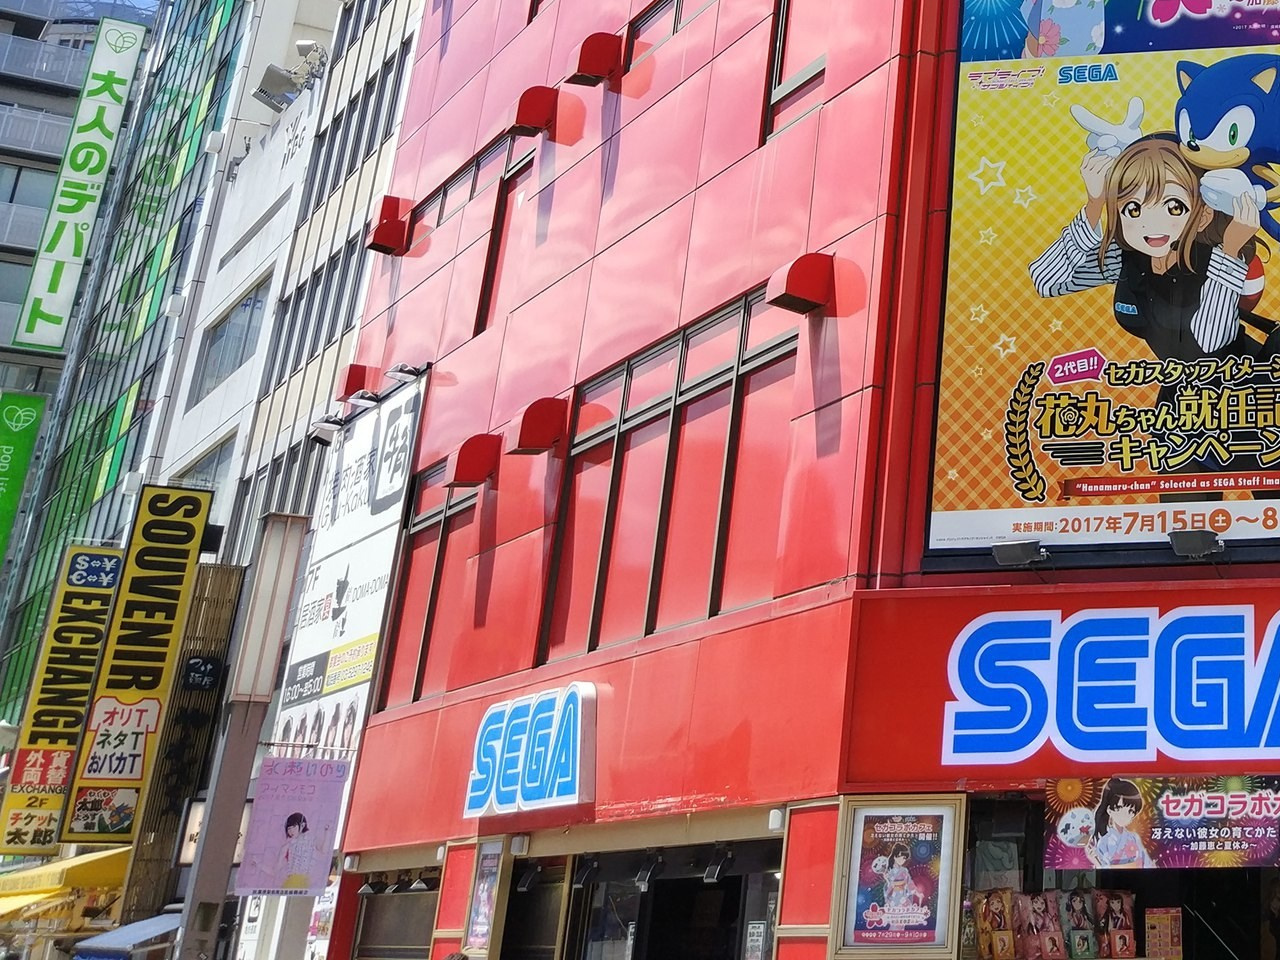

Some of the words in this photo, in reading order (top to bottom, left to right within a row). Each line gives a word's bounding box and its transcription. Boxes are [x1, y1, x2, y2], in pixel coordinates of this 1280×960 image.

[1058, 63, 1119, 84] SEGA
[25, 71, 128, 335] 大人のデパート
[1053, 356, 1100, 379] 2代目!!
[1159, 480, 1197, 489] Selected
[1213, 478, 1235, 487] SEGA
[1237, 477, 1260, 486] Staff
[108, 492, 202, 692] SOUVENIR
[28, 590, 111, 747] EXCHANGE
[103, 707, 149, 727] オリT
[97, 729, 144, 749] ネタT
[466, 687, 581, 814] SEGA
[87, 752, 141, 775] おバカT
[11, 784, 68, 795] EXCHANGE
[26, 796, 49, 808] 2F
[10, 812, 58, 825] チケット
[5, 828, 55, 845] 太郎
